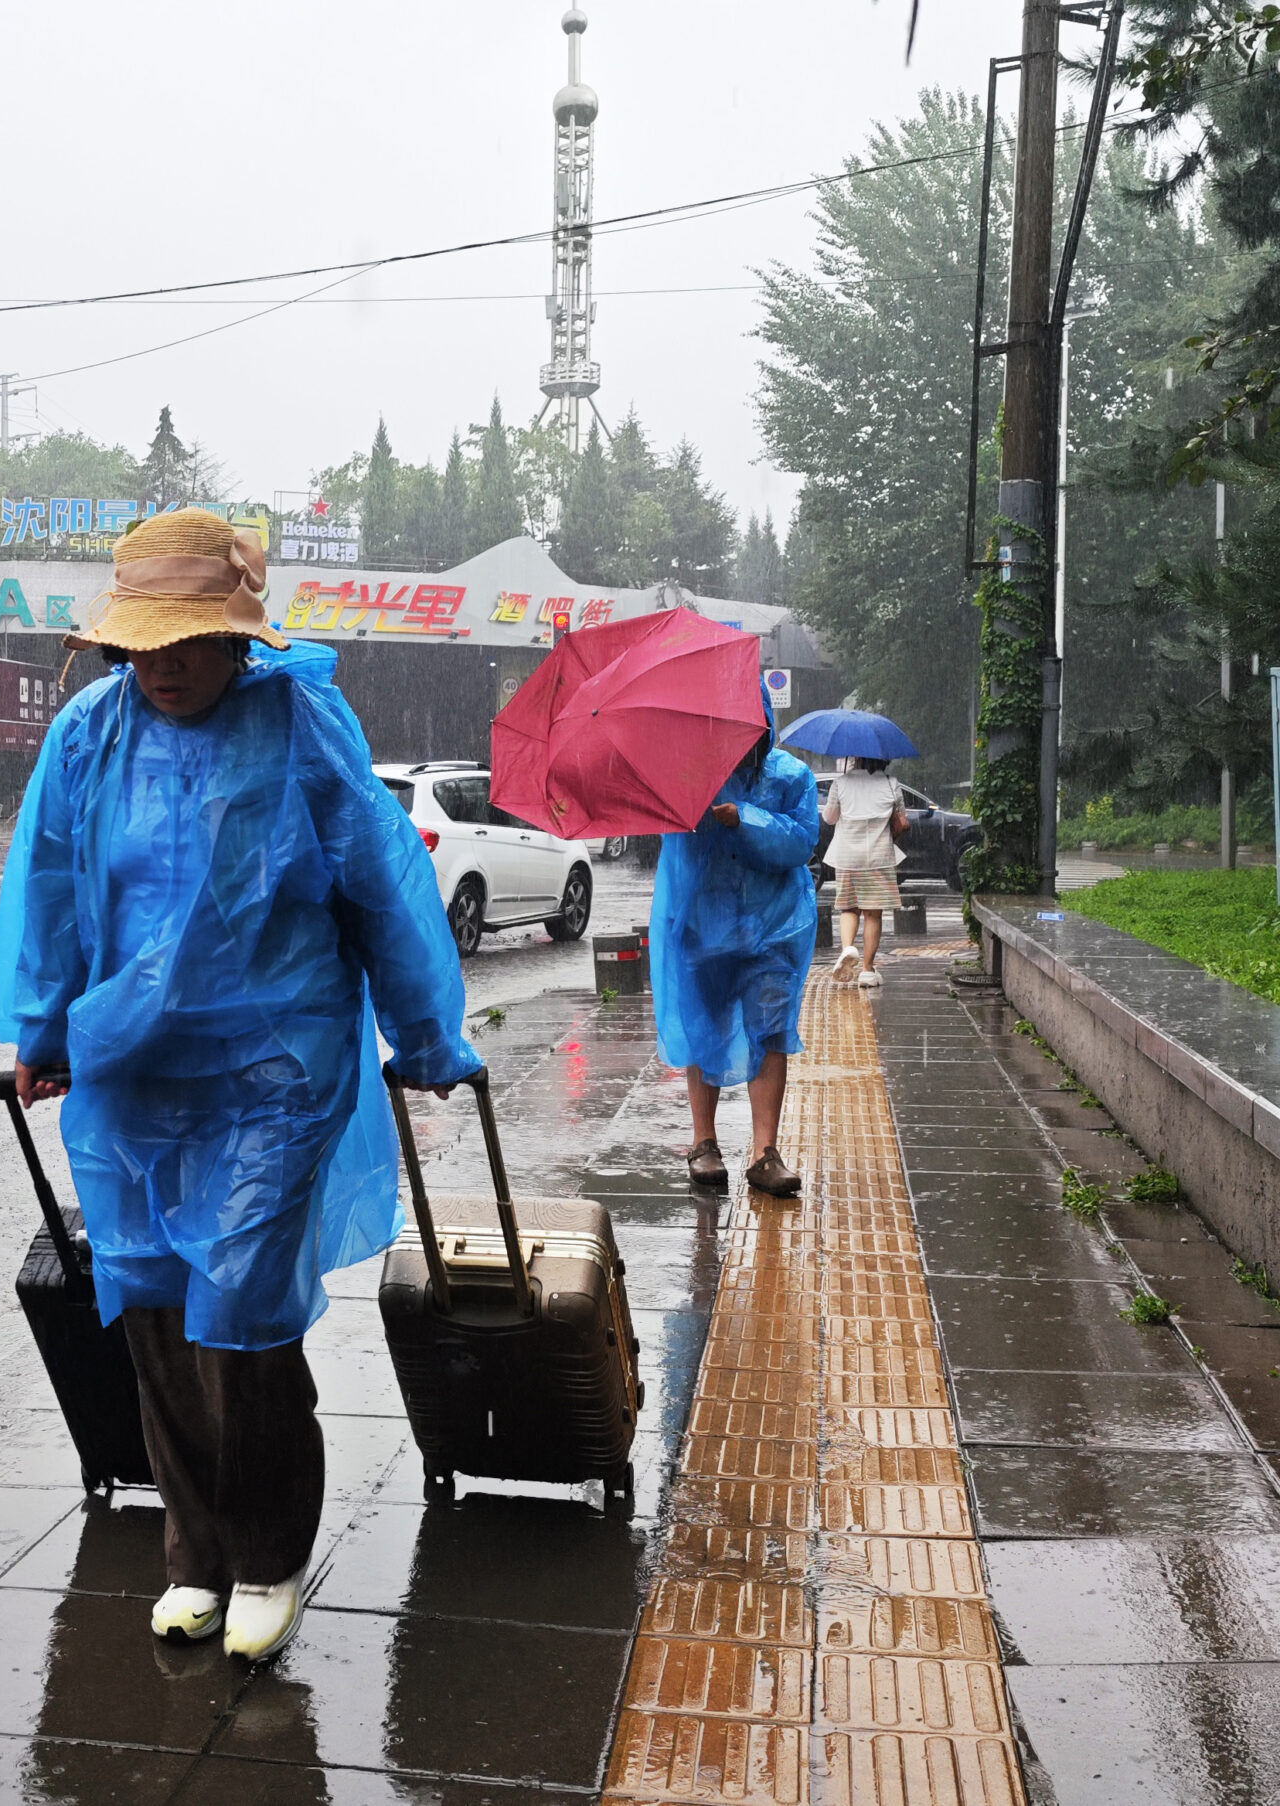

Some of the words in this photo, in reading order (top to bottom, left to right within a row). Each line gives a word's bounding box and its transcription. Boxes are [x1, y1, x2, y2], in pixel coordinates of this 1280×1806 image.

[0, 496, 270, 551] 沈阳最台
[282, 521, 360, 539] Heineken
[280, 539, 360, 563] 喜力啤酒
[284, 580, 471, 636] 时光里
